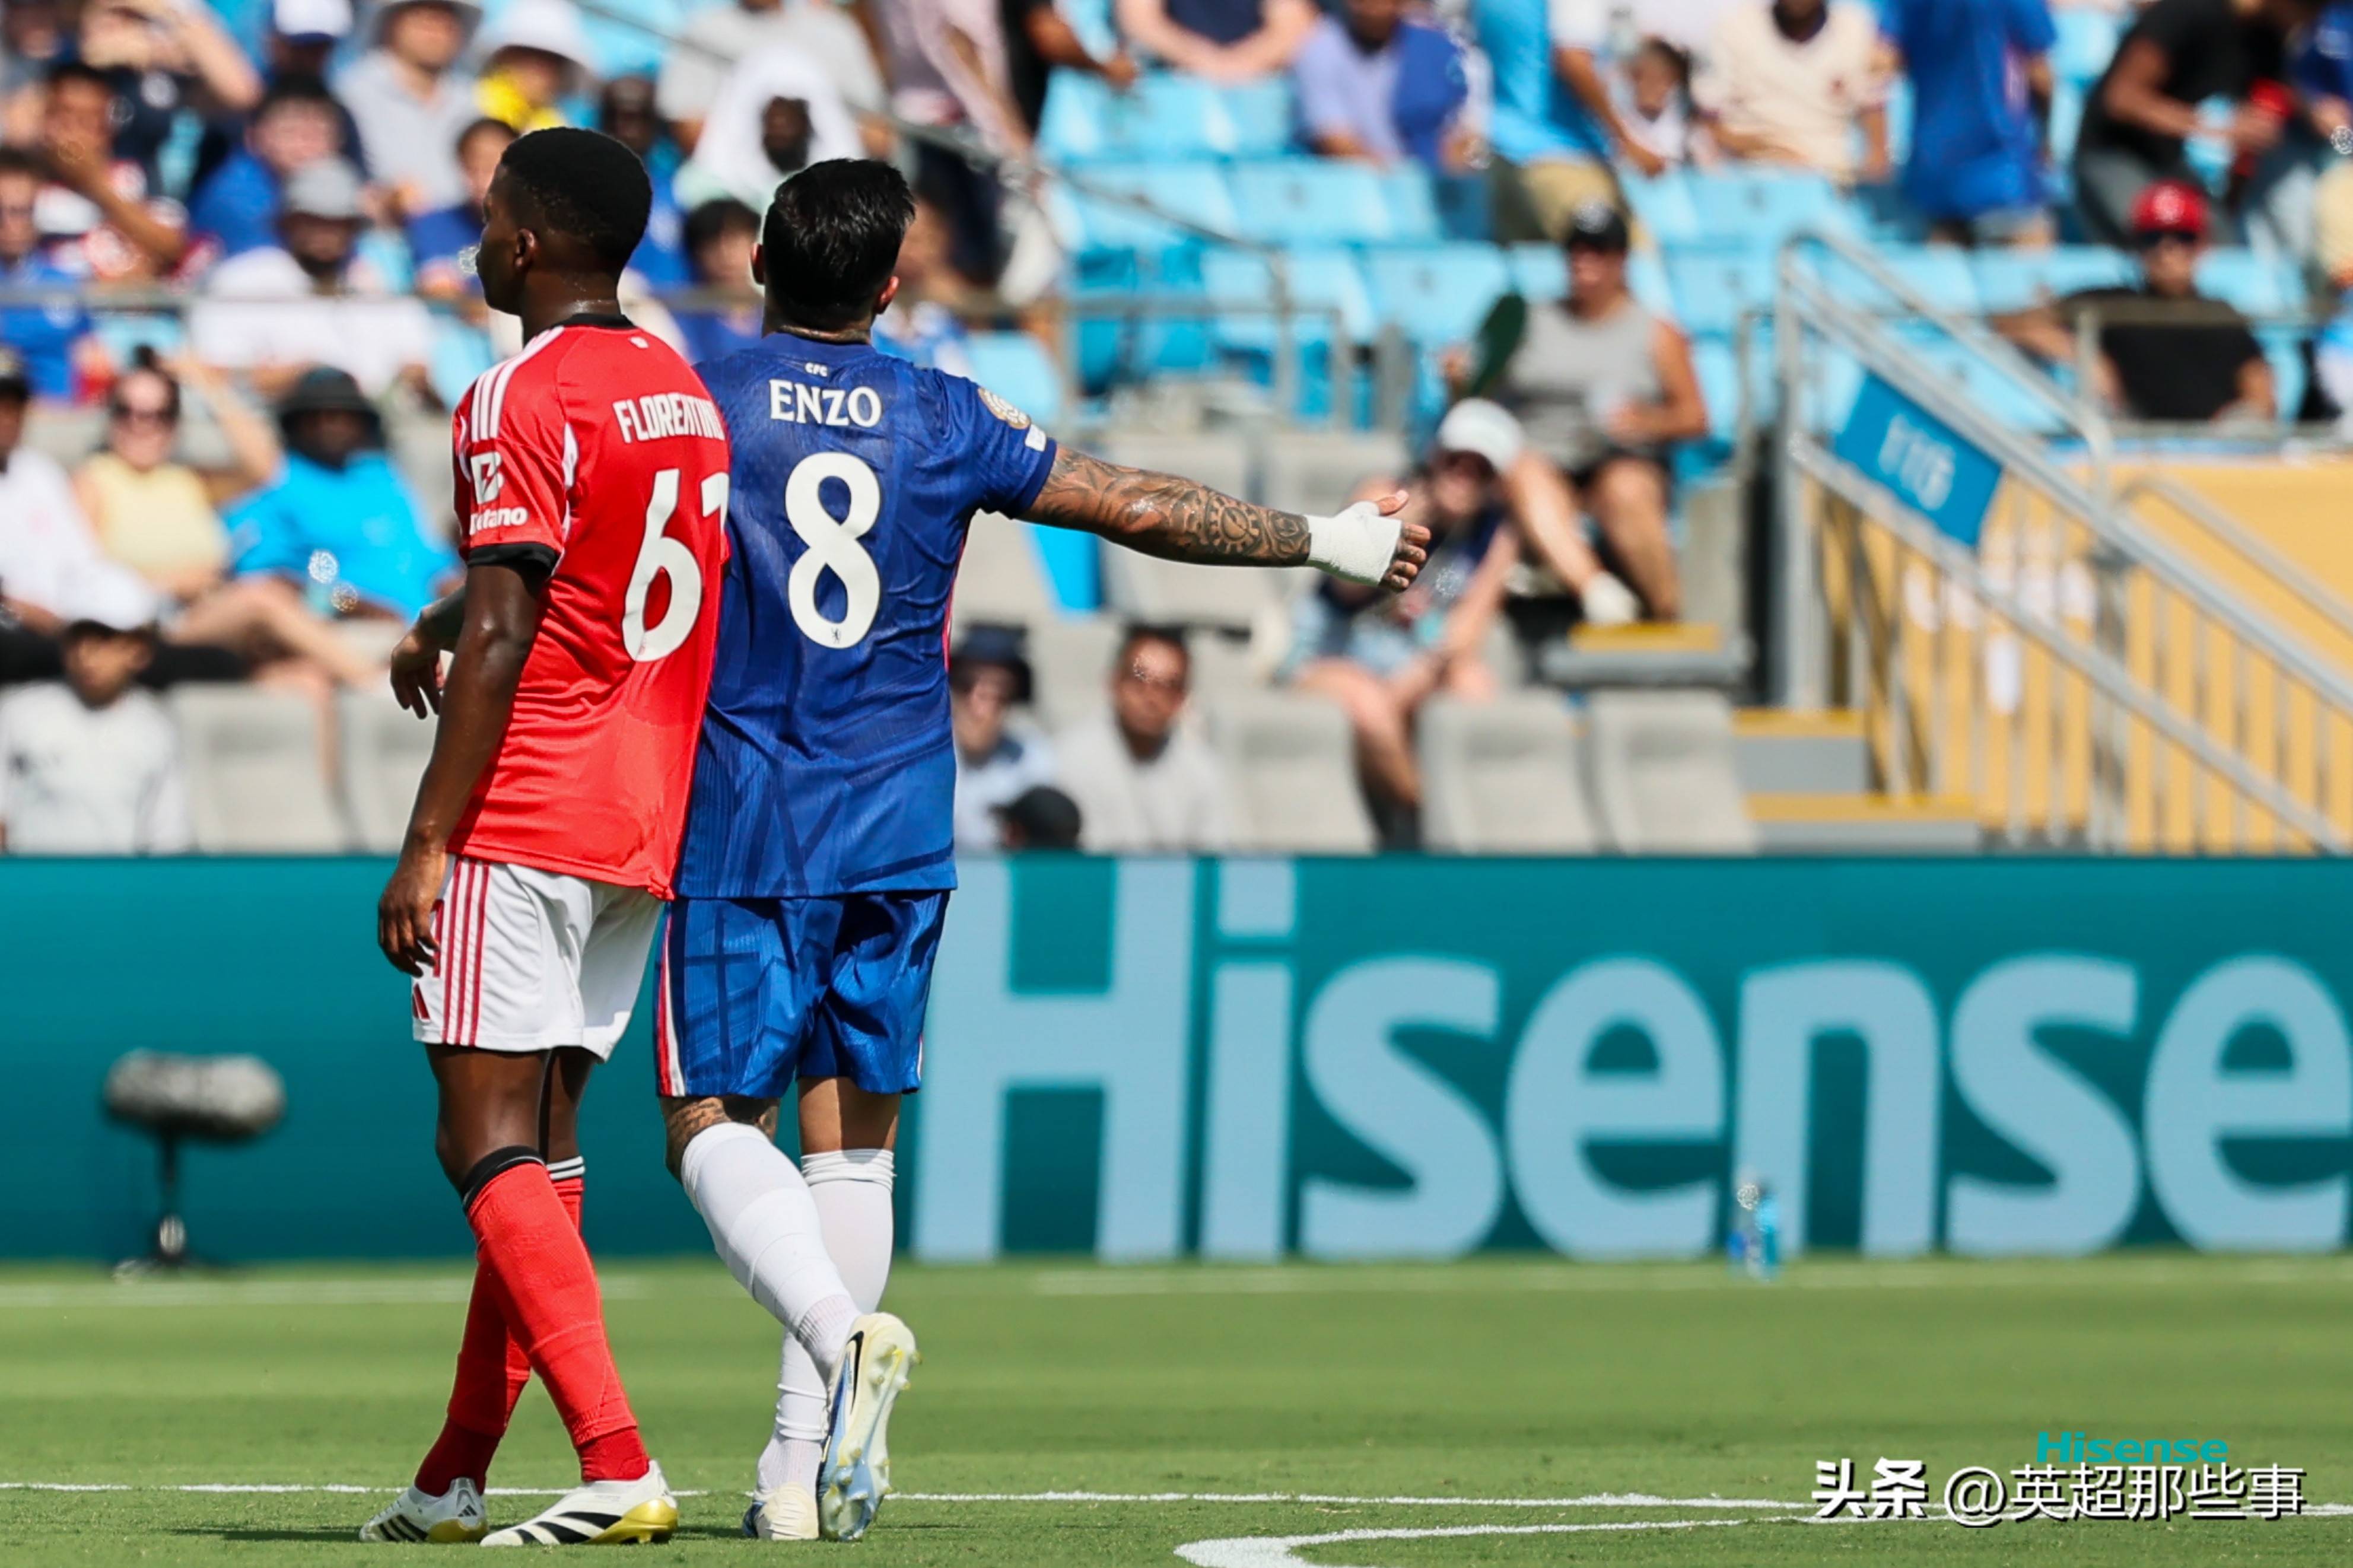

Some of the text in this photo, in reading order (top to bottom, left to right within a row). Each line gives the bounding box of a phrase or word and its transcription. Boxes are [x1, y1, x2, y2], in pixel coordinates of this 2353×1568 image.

[769, 379, 882, 428] ENZO
[805, 362, 828, 377] CFC
[785, 451, 880, 649] 8
[912, 858, 2353, 1259] Hisense
